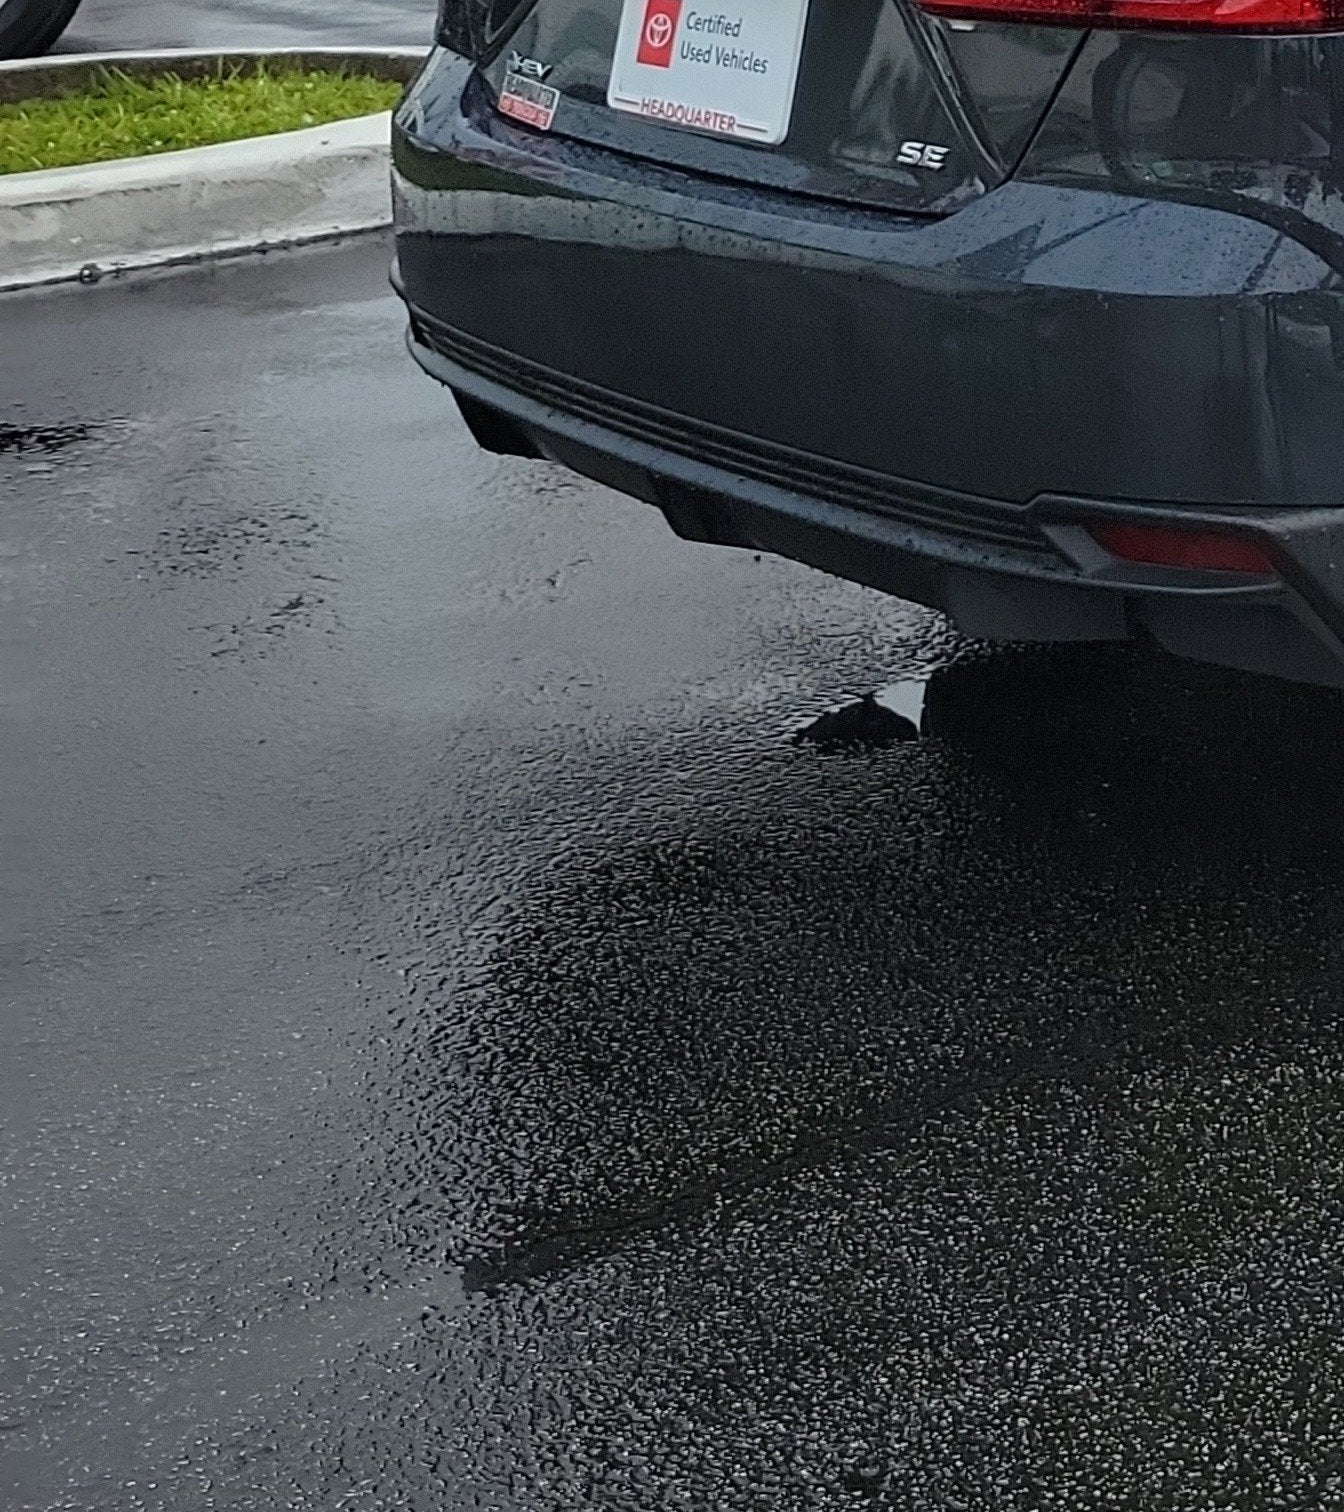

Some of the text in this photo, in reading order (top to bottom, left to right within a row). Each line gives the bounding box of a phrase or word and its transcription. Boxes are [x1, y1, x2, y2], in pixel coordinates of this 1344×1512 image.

[686, 10, 743, 38] Certified
[680, 40, 769, 75] Used Vehicles
[640, 98, 737, 133] HEADQUARTER
[896, 141, 952, 170] SE
